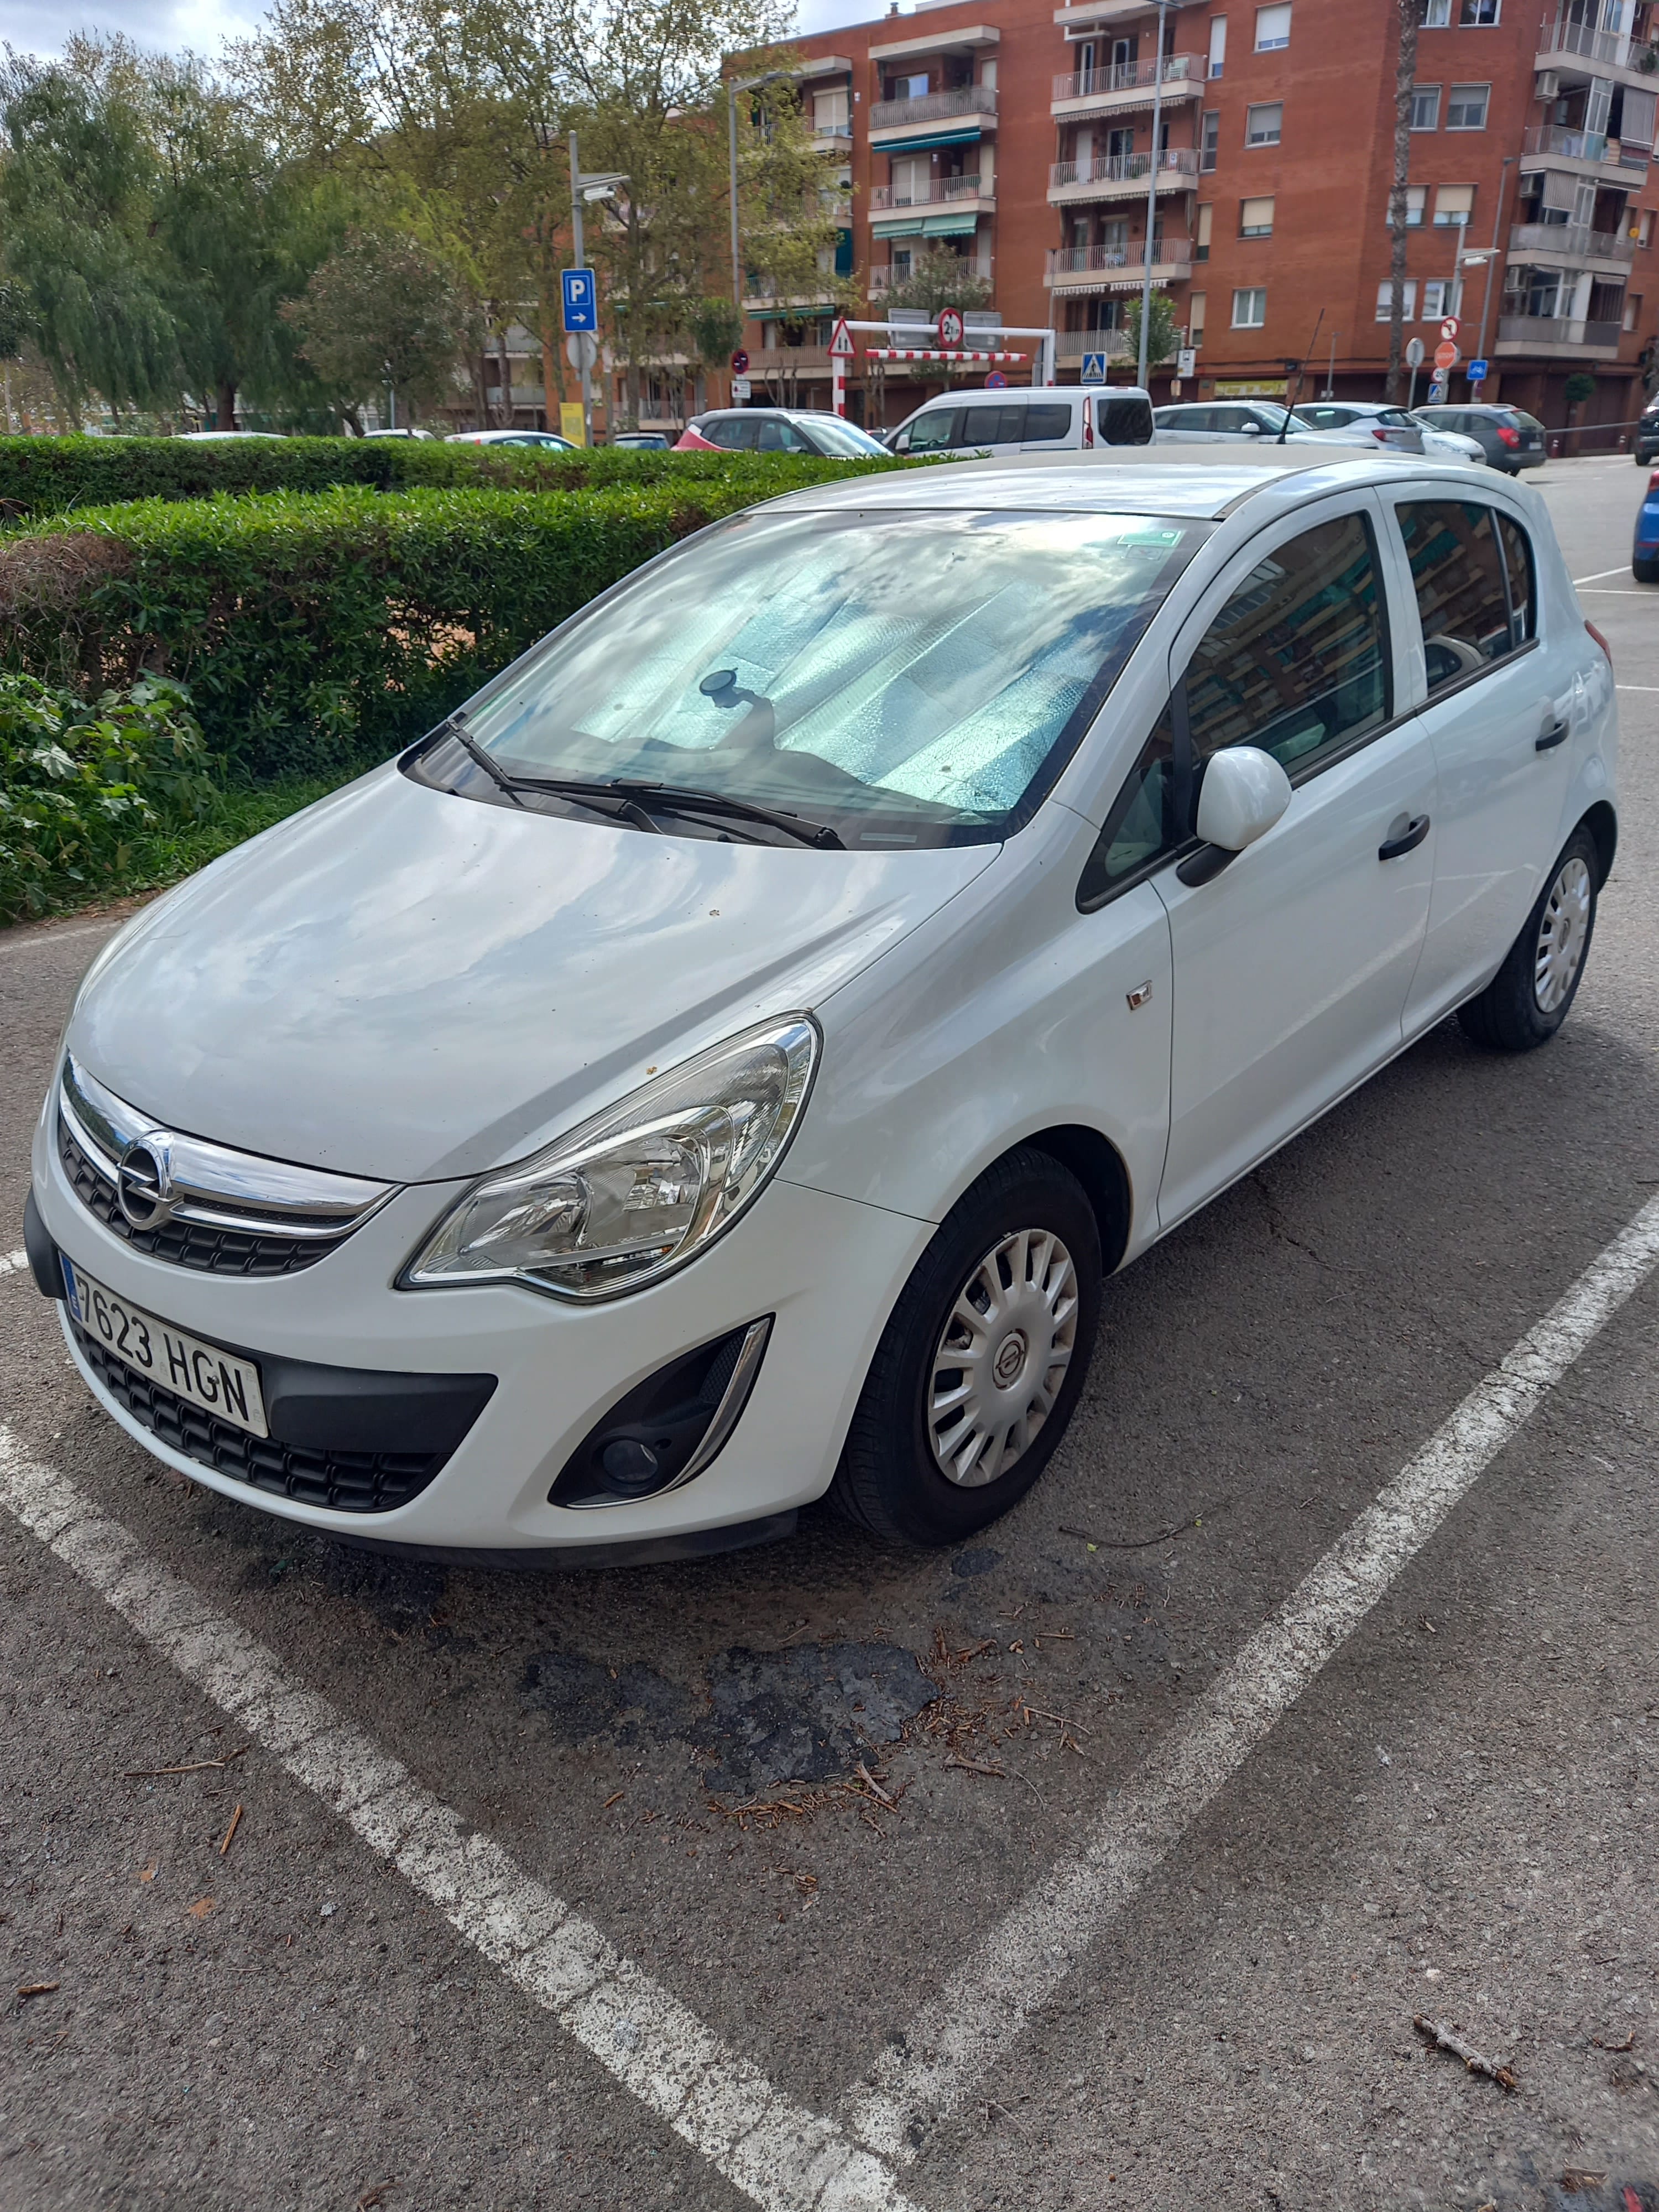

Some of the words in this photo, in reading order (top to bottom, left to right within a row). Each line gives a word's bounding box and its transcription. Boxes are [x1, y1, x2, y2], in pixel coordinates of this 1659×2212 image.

[570, 279, 585, 301] P
[75, 1273, 153, 1368] 7623
[163, 1333, 249, 1422] HGN
